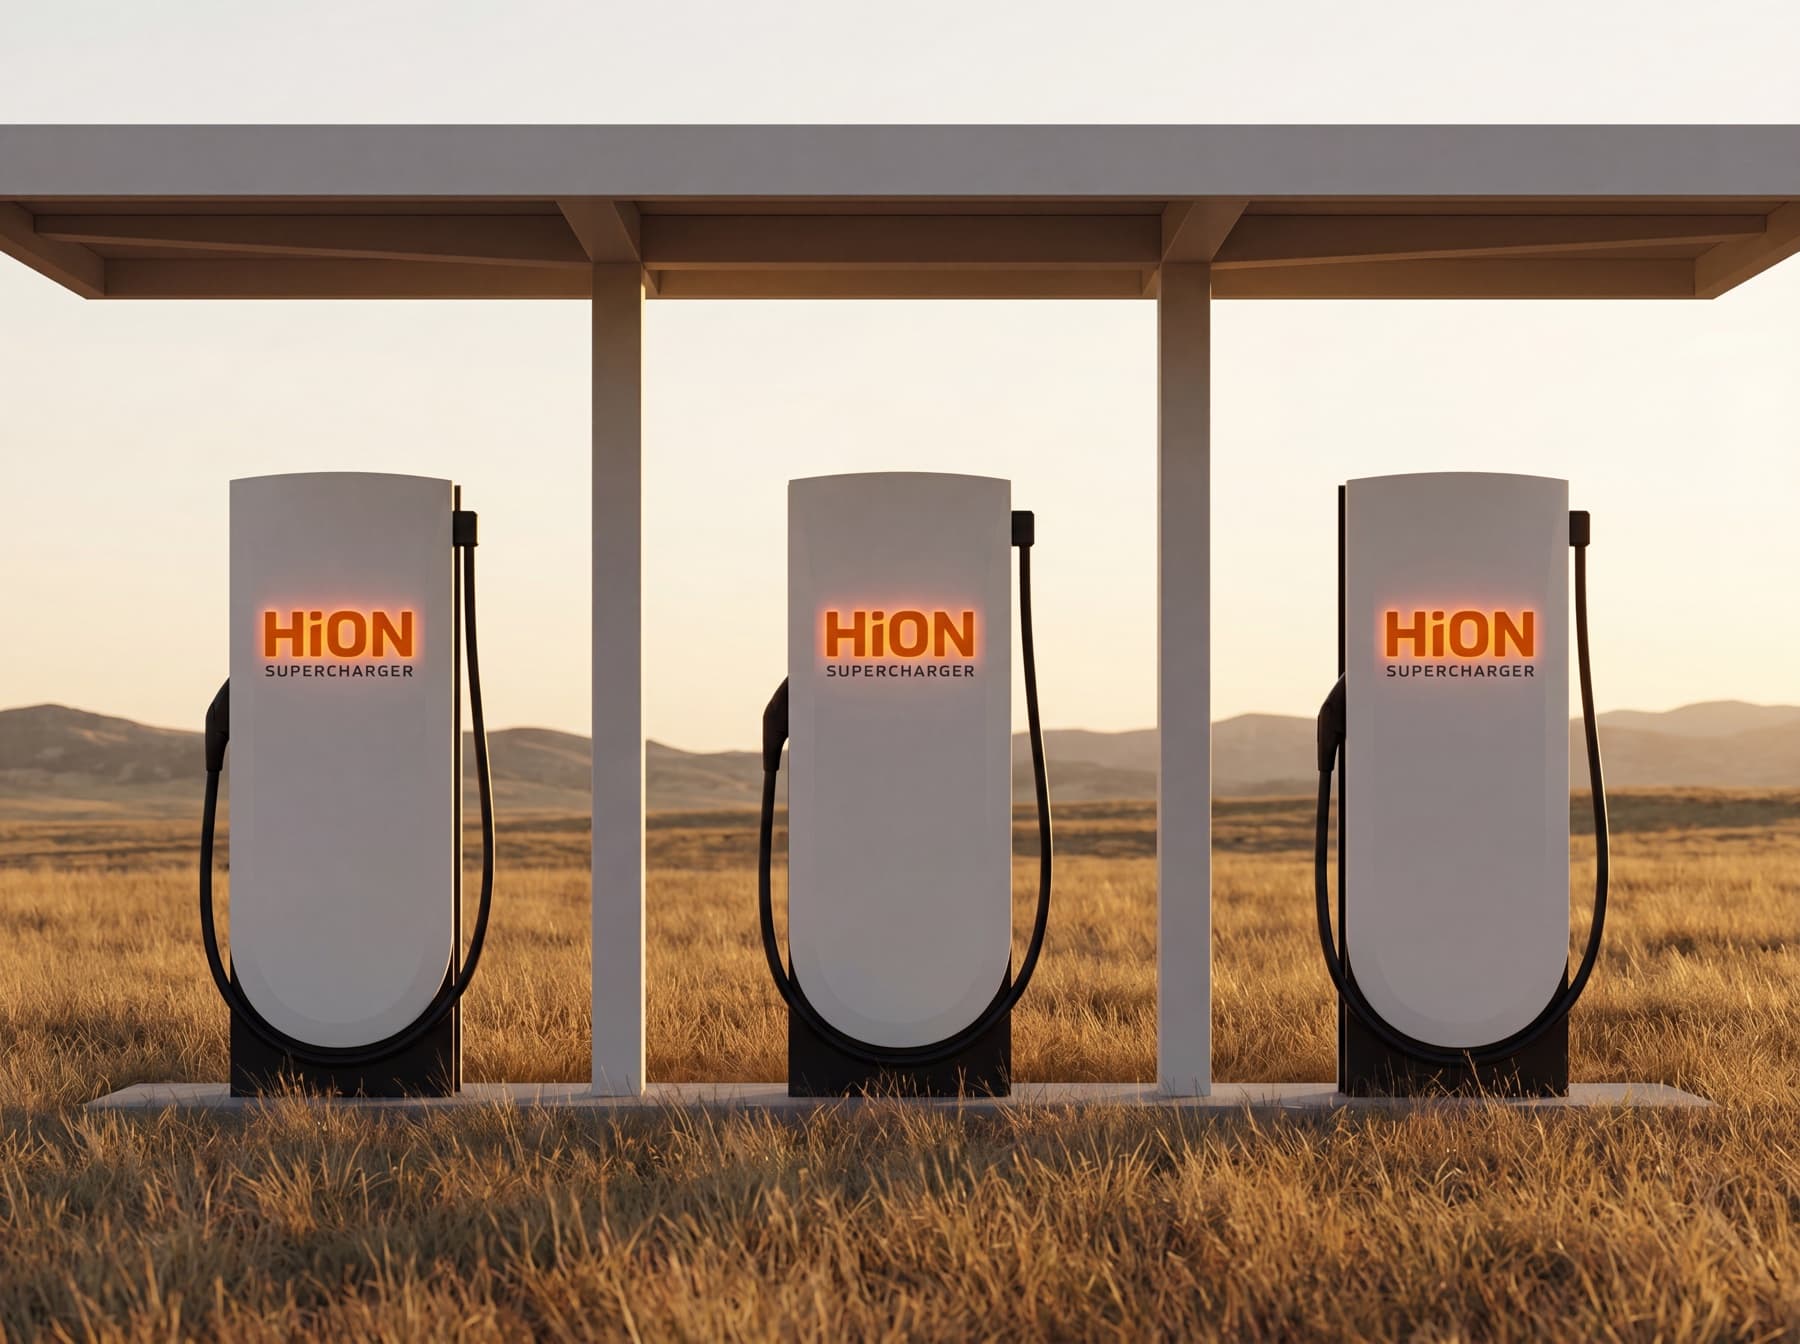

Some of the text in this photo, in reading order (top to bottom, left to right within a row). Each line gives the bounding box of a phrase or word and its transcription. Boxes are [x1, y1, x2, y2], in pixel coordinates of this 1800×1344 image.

[265, 610, 413, 658] HiON
[826, 610, 974, 658] HiON
[1386, 610, 1534, 658] HiON
[265, 664, 413, 678] SUPERCHARGER
[826, 664, 974, 678] SUPERCHARGER
[1386, 664, 1534, 678] SUPERCHARGER
